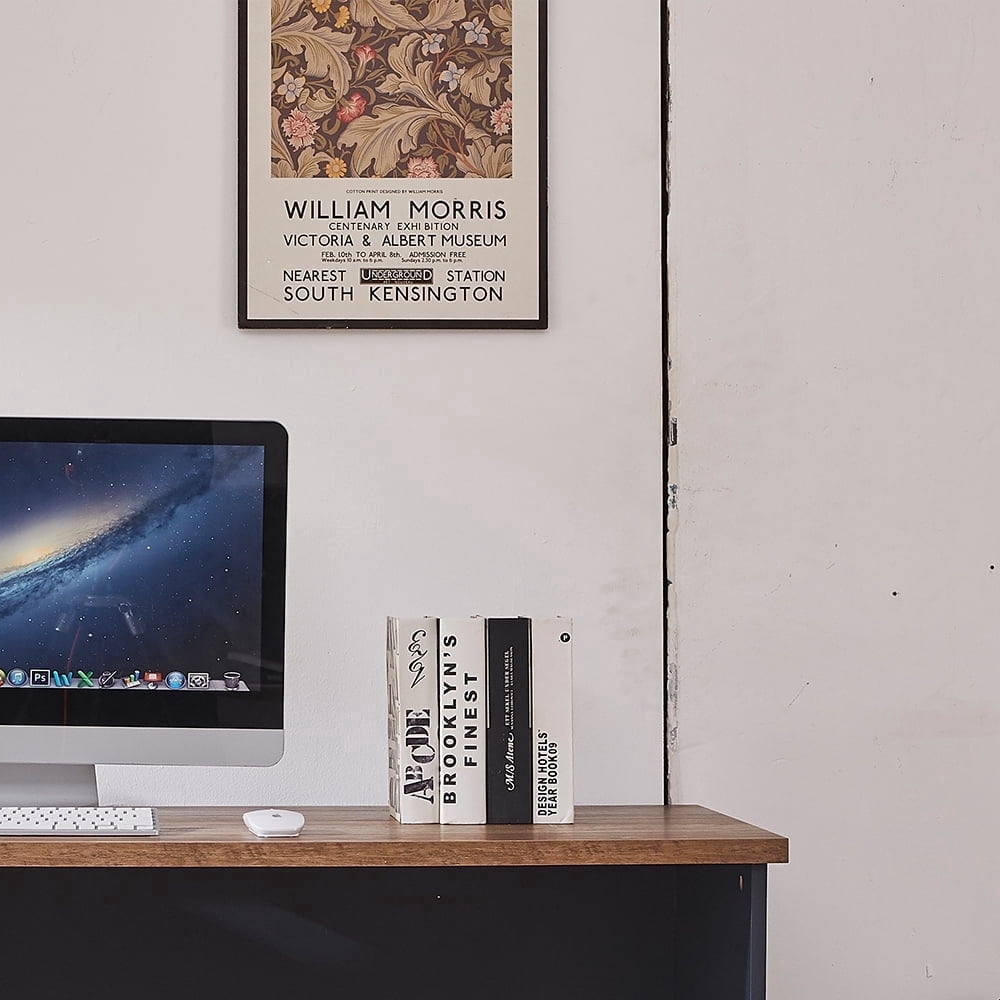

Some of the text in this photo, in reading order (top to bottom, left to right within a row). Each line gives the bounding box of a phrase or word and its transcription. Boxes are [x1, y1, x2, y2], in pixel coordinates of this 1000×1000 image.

[284, 200, 507, 220] WILLIAM MORRIS
[328, 222, 391, 231] CENTENARY
[283, 234, 507, 247] VICTORIA & ALBERT MUSEUM
[283, 268, 506, 282] NEAREST UNDERGROUND STATION
[283, 286, 503, 302] SOUTH KENSINGTON
[34, 673, 46, 682] Ps
[443, 635, 457, 804] BROOKLYN'S
[464, 672, 478, 767] FINEST
[403, 708, 435, 805] ABCDE
[537, 777, 548, 816] DESIGN
[548, 788, 558, 816] YEAR
